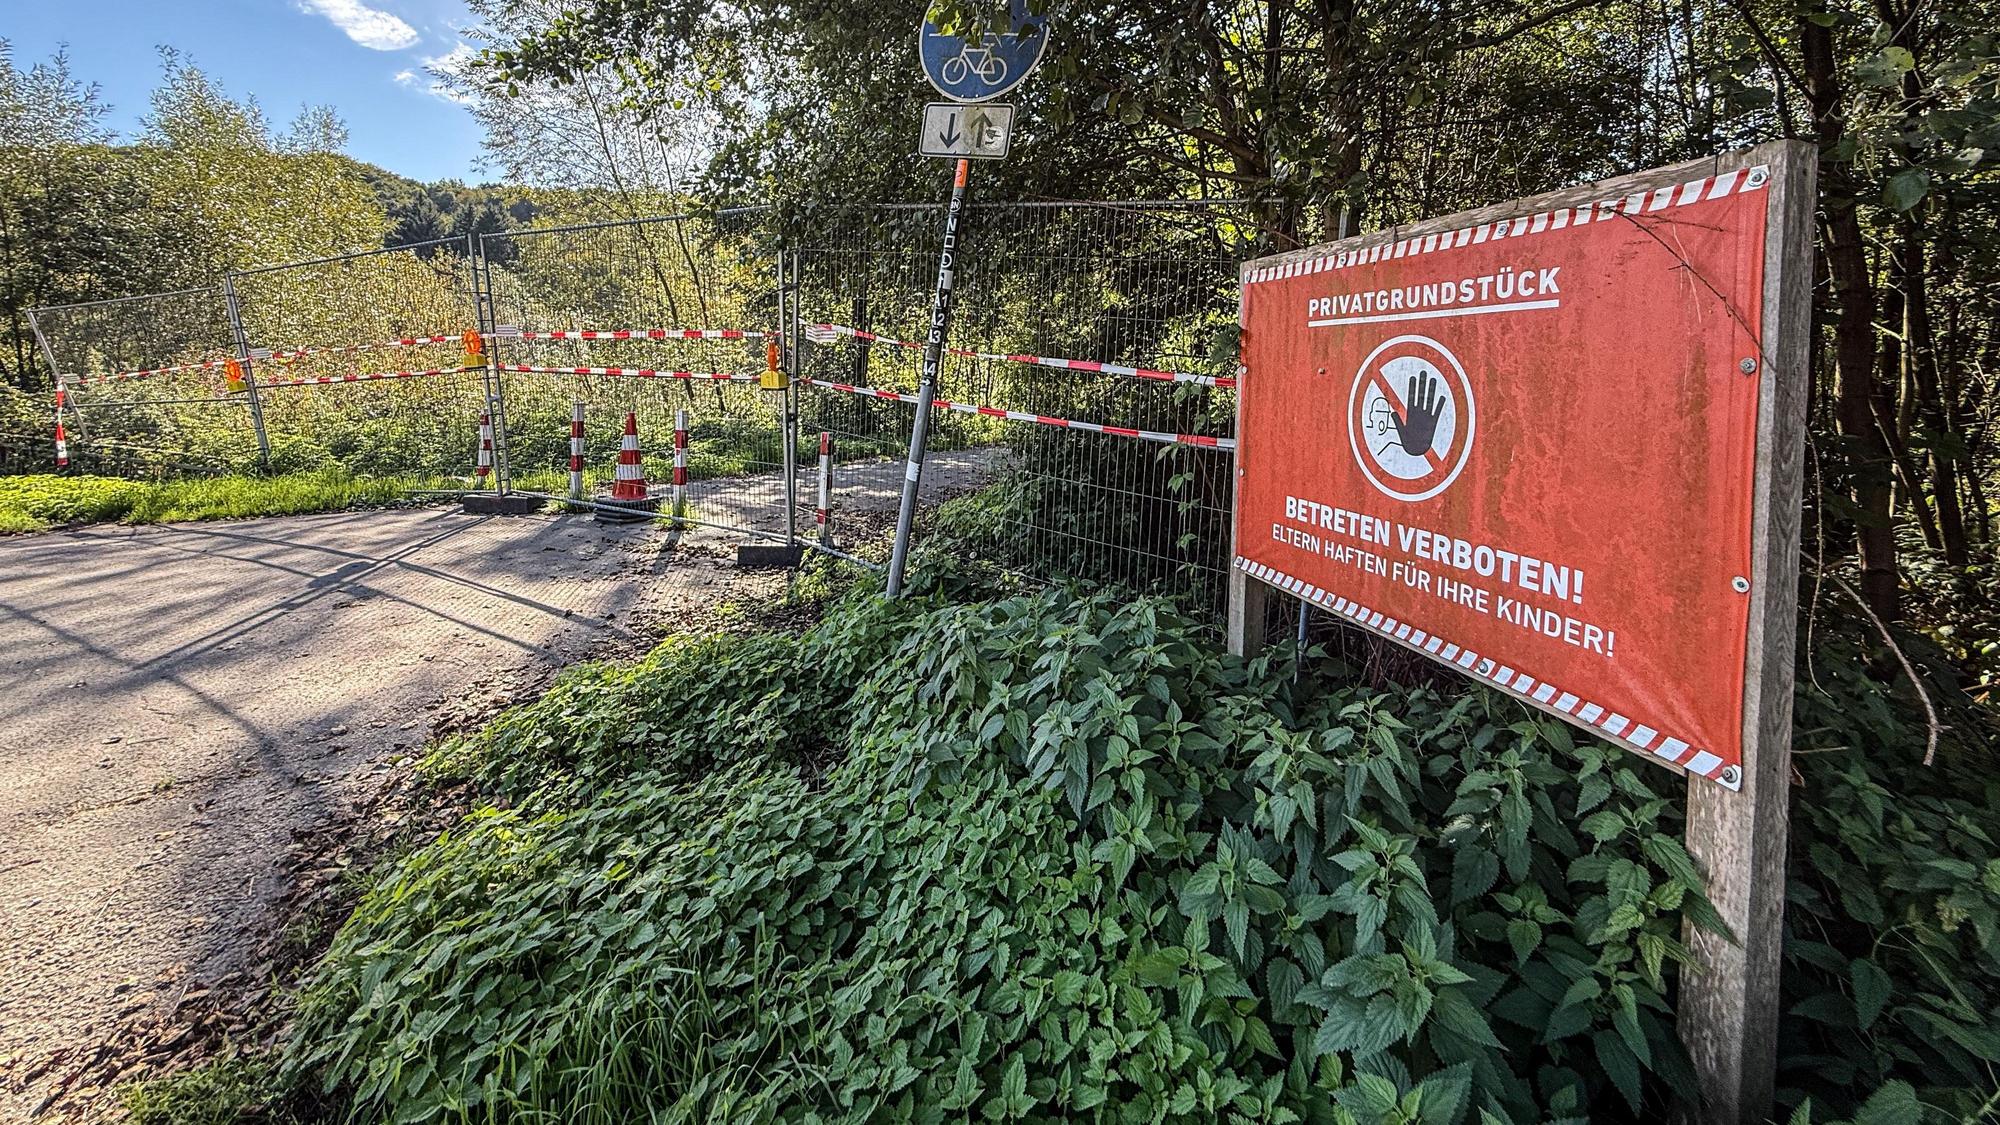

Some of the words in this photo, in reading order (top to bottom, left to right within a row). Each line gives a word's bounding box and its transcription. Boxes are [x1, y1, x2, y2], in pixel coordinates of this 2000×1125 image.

[1307, 266, 1561, 318] PRIVATGRUNDSTÜCK
[1272, 523, 1321, 554] ELTERN
[1324, 539, 1387, 578] HAFTEN
[1392, 559, 1431, 593] FÜR
[1437, 576, 1490, 614] IHRE
[1497, 595, 1615, 658] KINDER!
[1285, 495, 1391, 547] BETRETEN
[1397, 523, 1584, 605] VERBOTEN!
